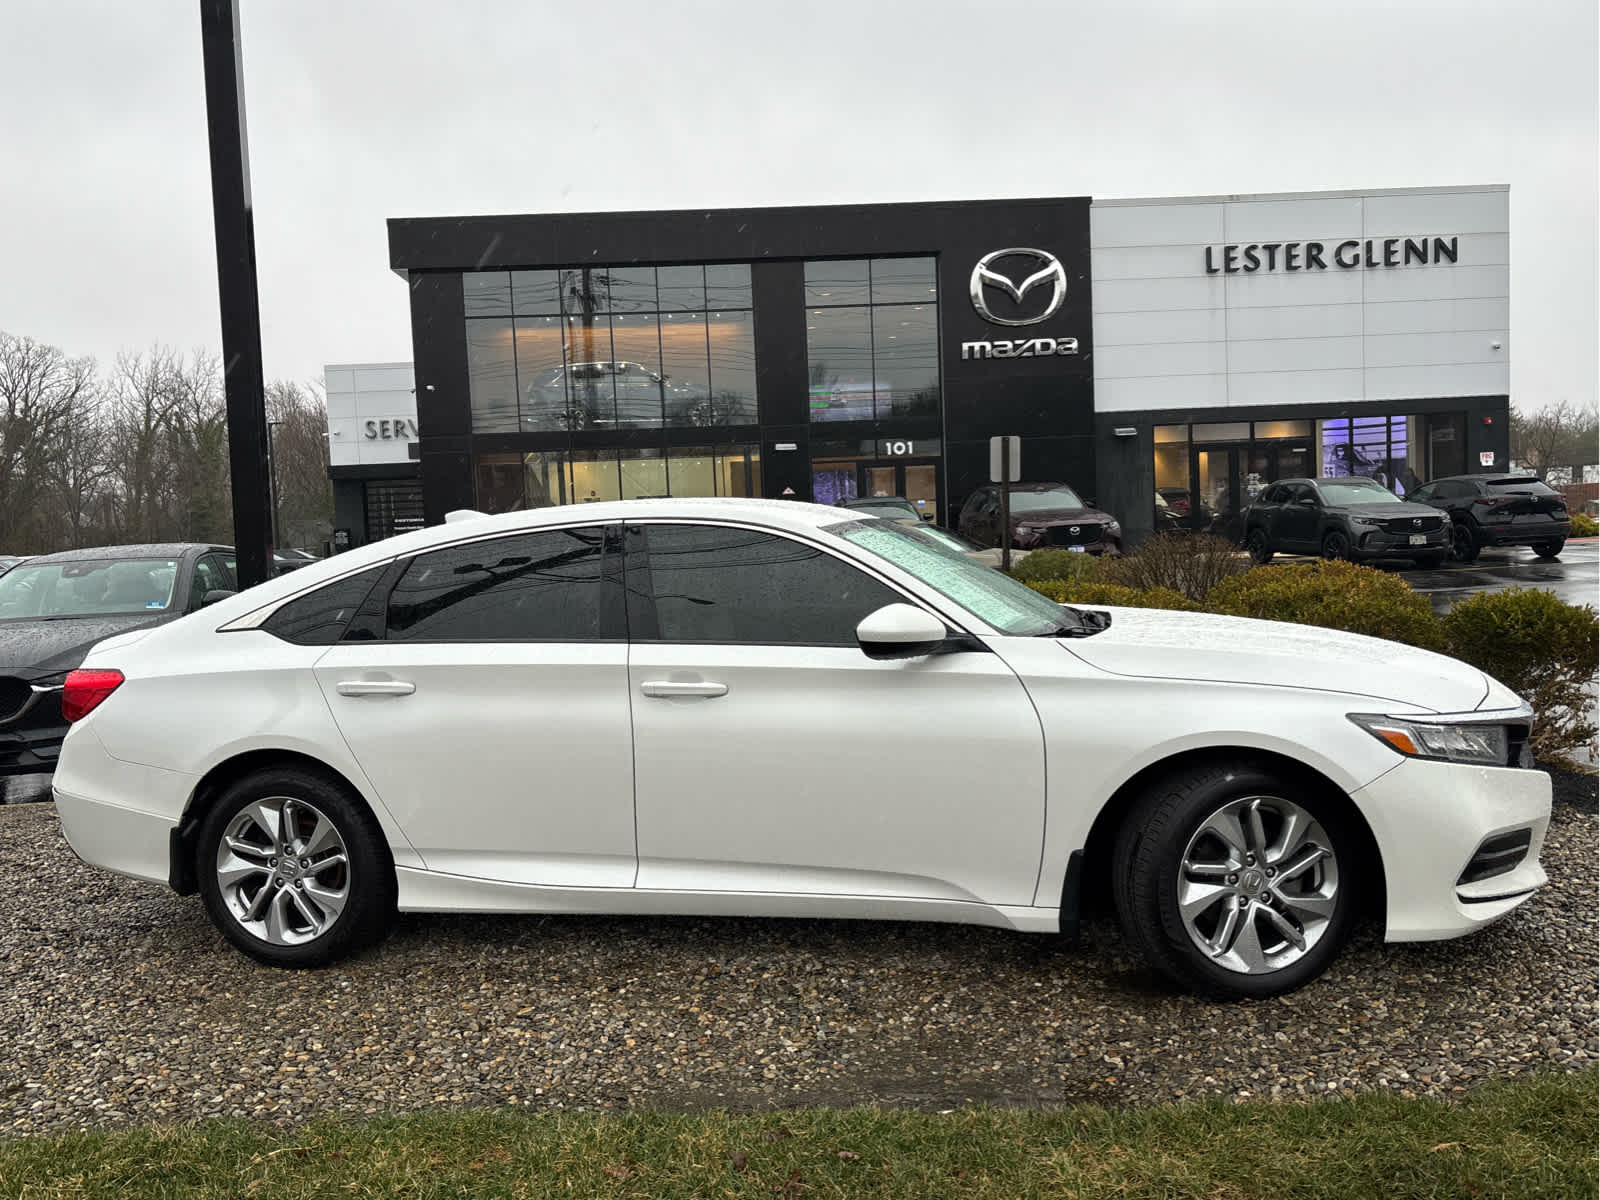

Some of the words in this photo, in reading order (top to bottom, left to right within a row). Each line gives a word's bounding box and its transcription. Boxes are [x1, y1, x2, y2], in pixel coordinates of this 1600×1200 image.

[1205, 242, 1328, 274] LESTER
[1334, 236, 1459, 269] GLENN
[885, 441, 913, 456] 101
